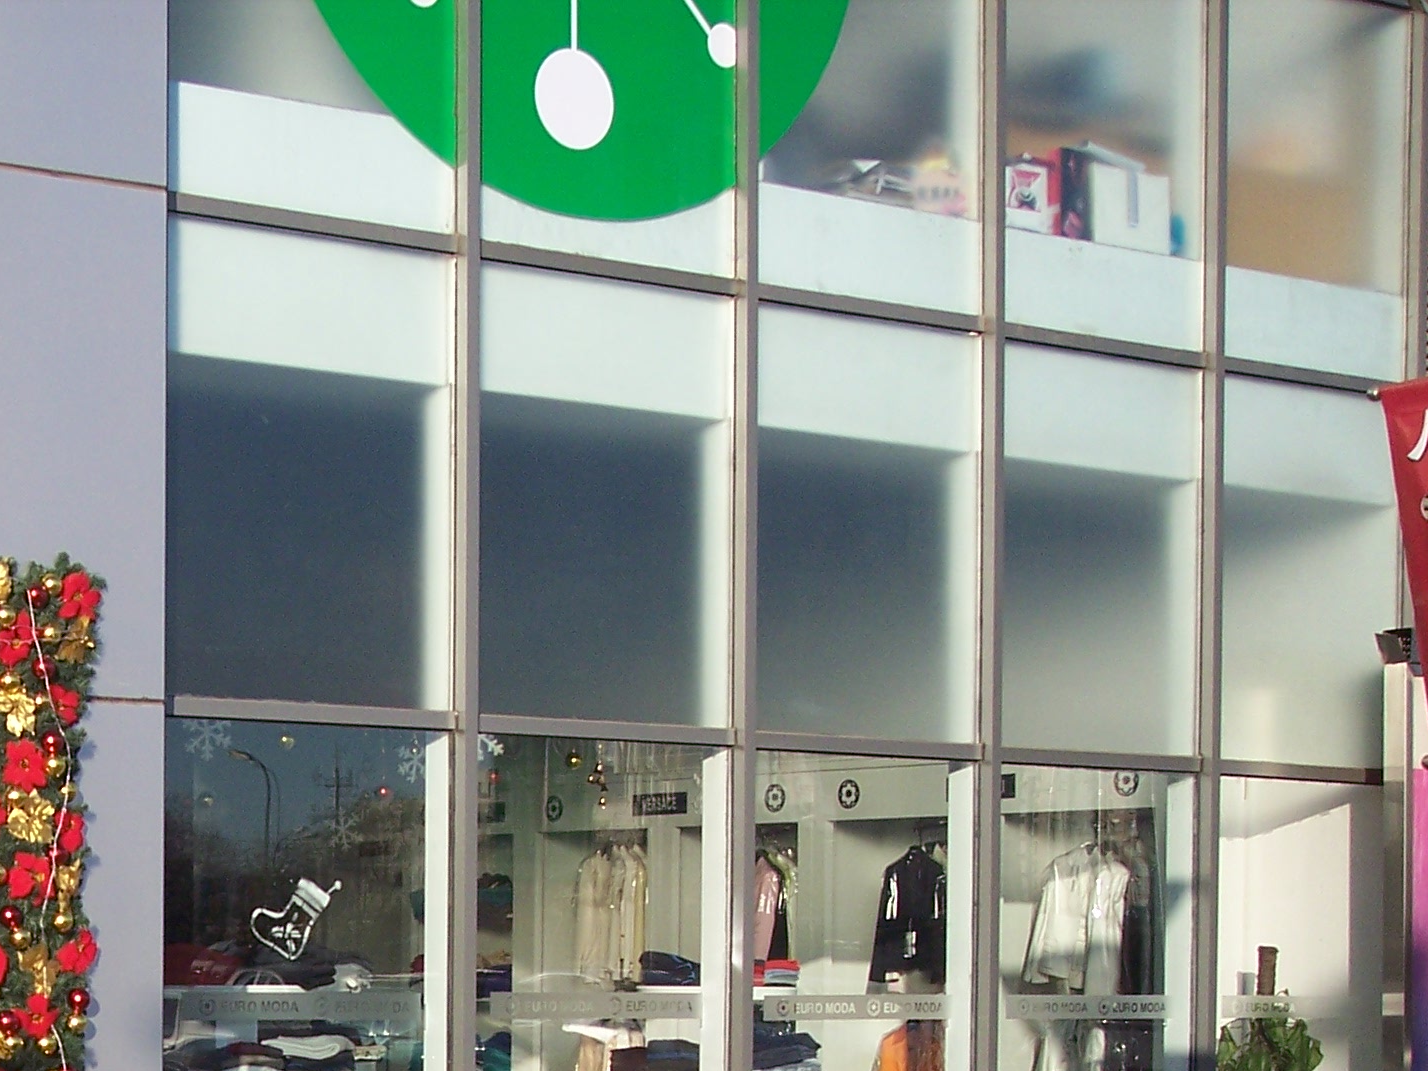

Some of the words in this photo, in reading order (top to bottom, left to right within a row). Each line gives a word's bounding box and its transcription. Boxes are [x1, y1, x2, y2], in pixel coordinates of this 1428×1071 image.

[794, 1002, 823, 1014] EURO
[825, 1002, 856, 1014] MODA
[1140, 1002, 1166, 1013] MODA
